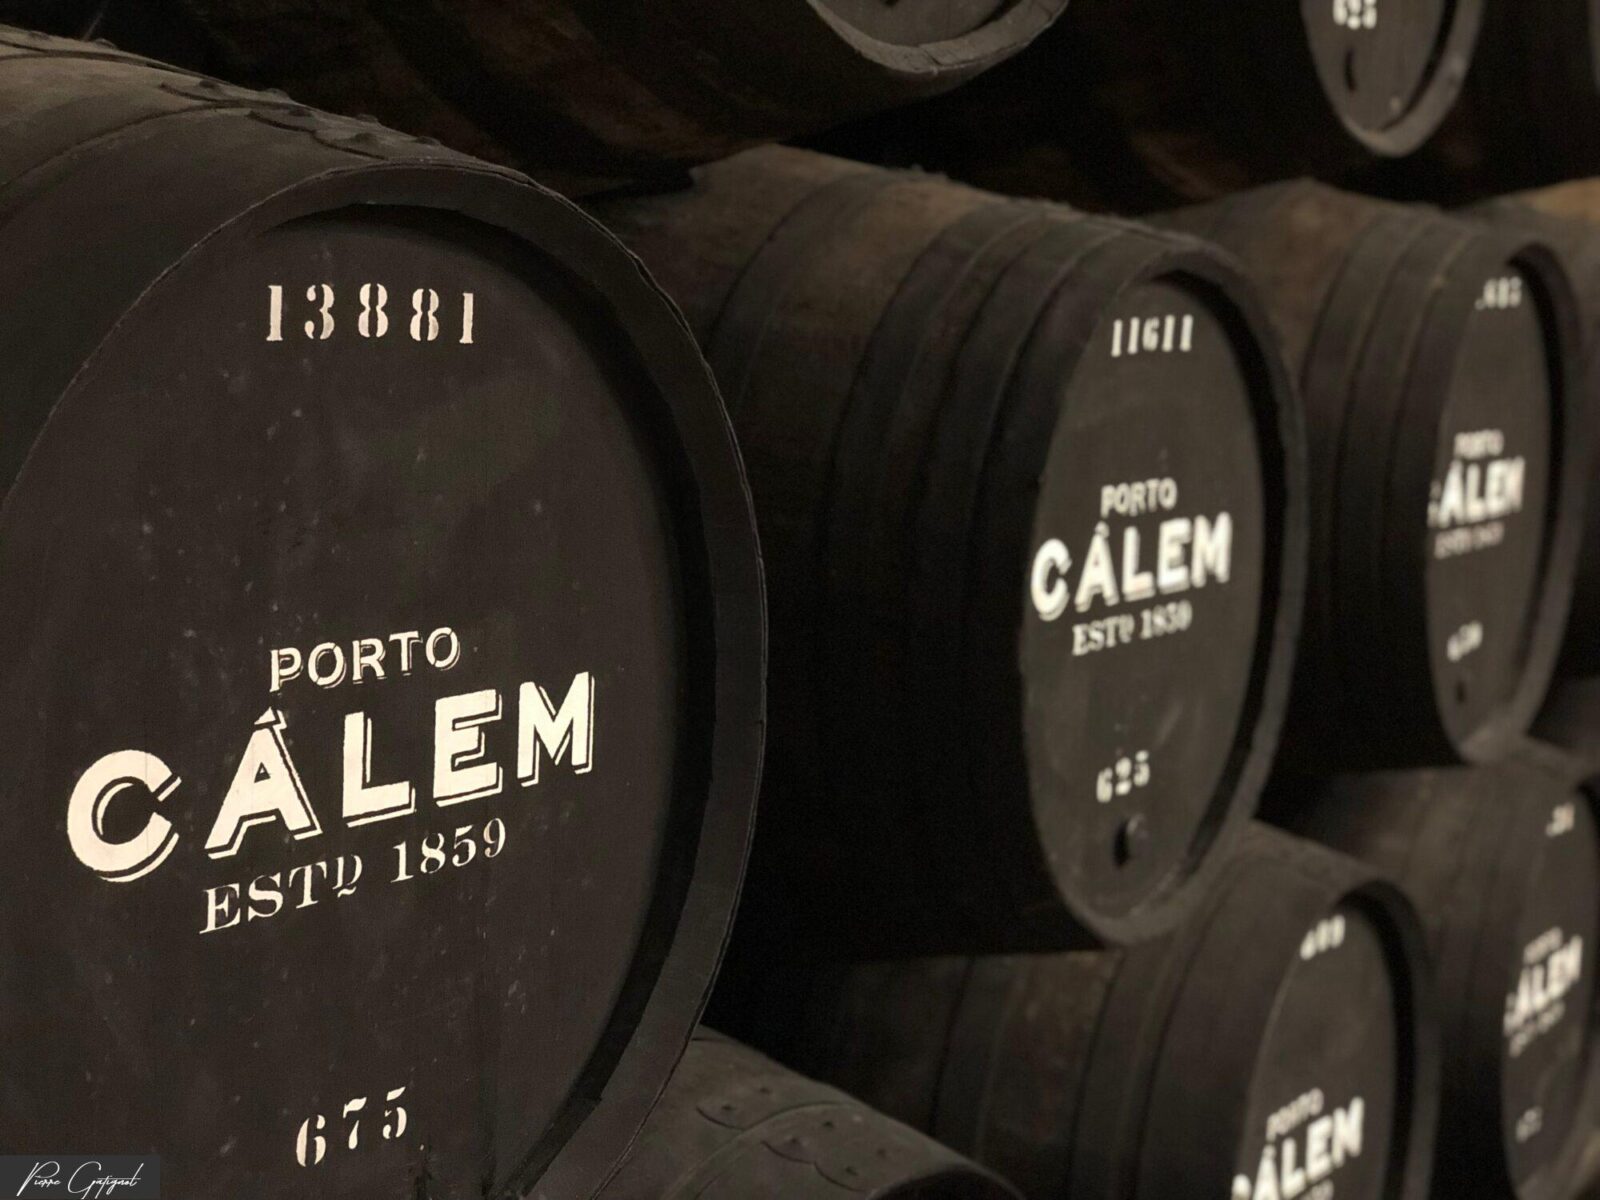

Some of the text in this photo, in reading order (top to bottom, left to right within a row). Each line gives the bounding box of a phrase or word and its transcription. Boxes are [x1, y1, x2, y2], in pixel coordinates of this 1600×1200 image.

[266, 282, 474, 345] 13881
[1111, 314, 1193, 357] 11611
[1101, 477, 1178, 518] PORTO
[1030, 510, 1233, 622] CÁLEM
[270, 626, 462, 694] PORTO
[67, 670, 595, 883] CÁLEM
[199, 816, 507, 935] ESTD 1859
[295, 1086, 408, 1168] 675
